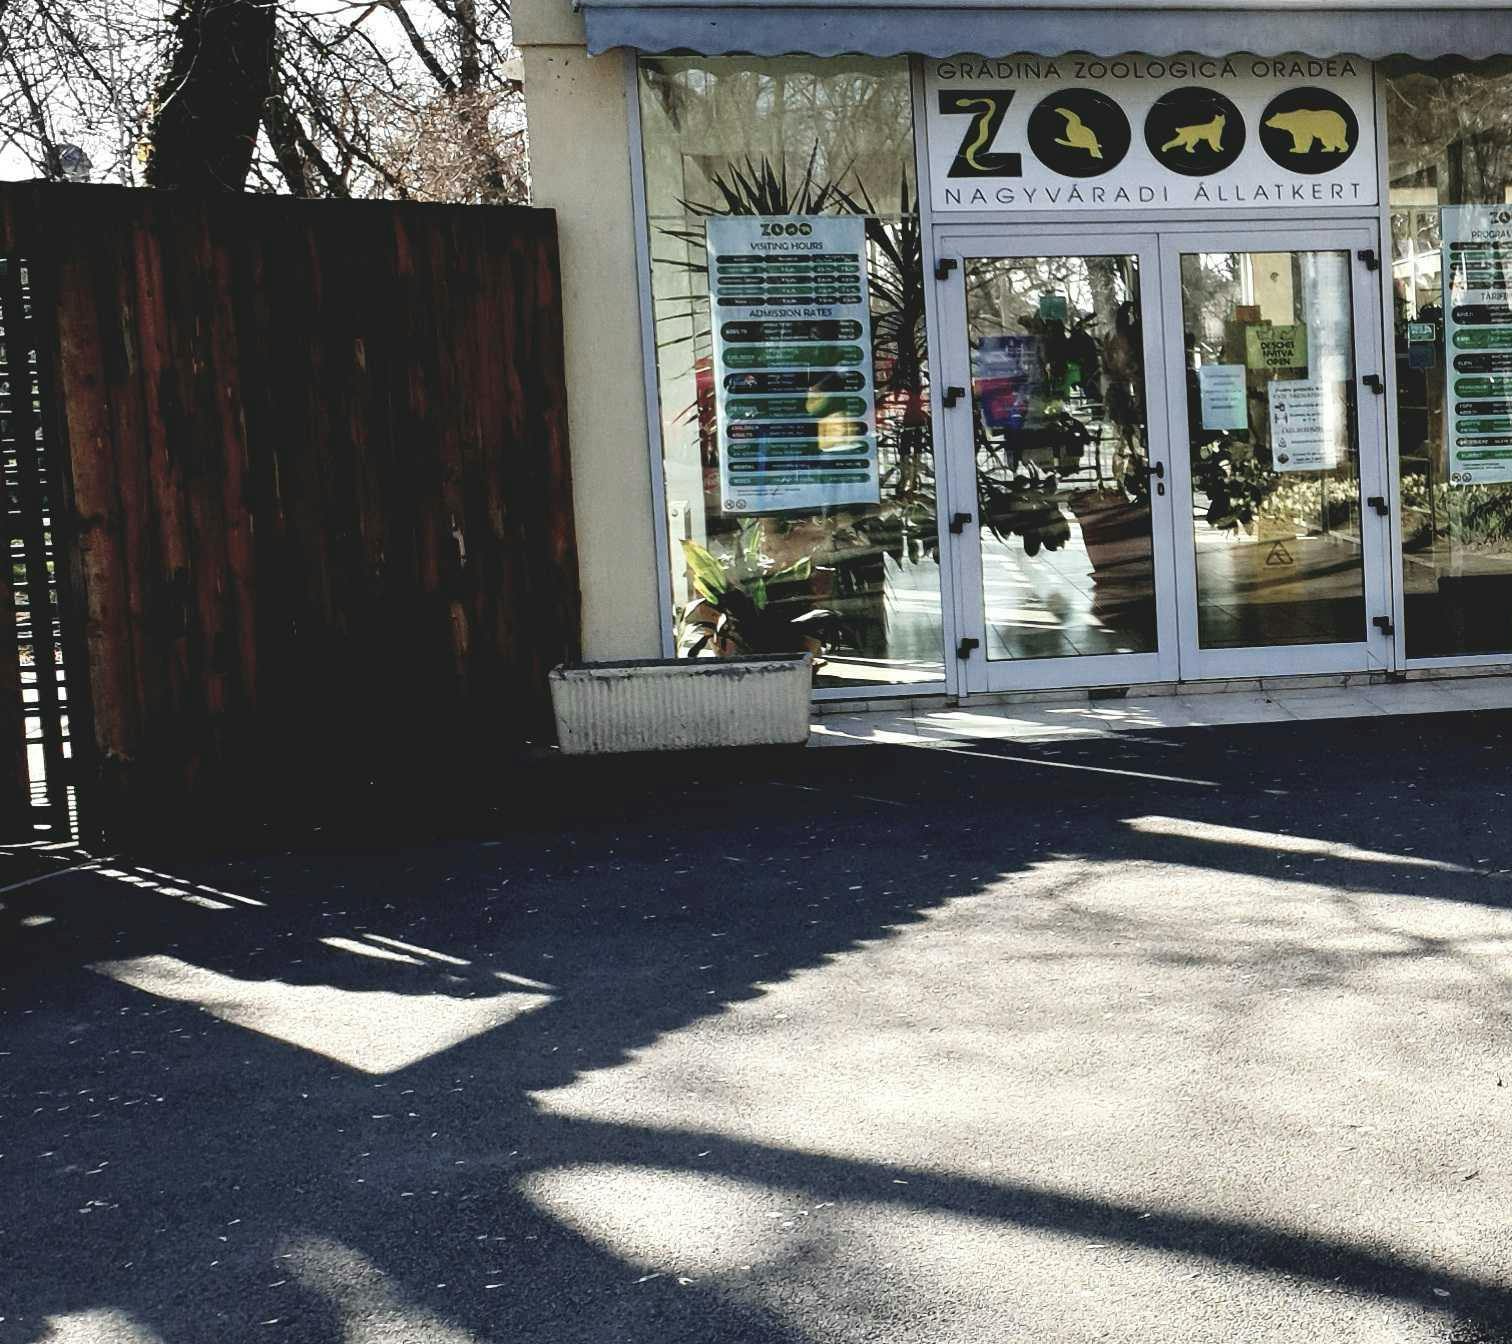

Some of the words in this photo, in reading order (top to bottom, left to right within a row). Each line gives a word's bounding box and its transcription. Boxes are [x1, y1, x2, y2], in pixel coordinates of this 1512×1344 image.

[1251, 60, 1358, 78] ORADEA
[945, 182, 1169, 205] NAGYVÁRADI
[1193, 182, 1361, 203] ÁLLATKERT
[750, 242, 789, 251] VISITING
[791, 241, 824, 250] HOURS
[749, 308, 802, 318] ADMISSION
[803, 307, 833, 317] RATES
